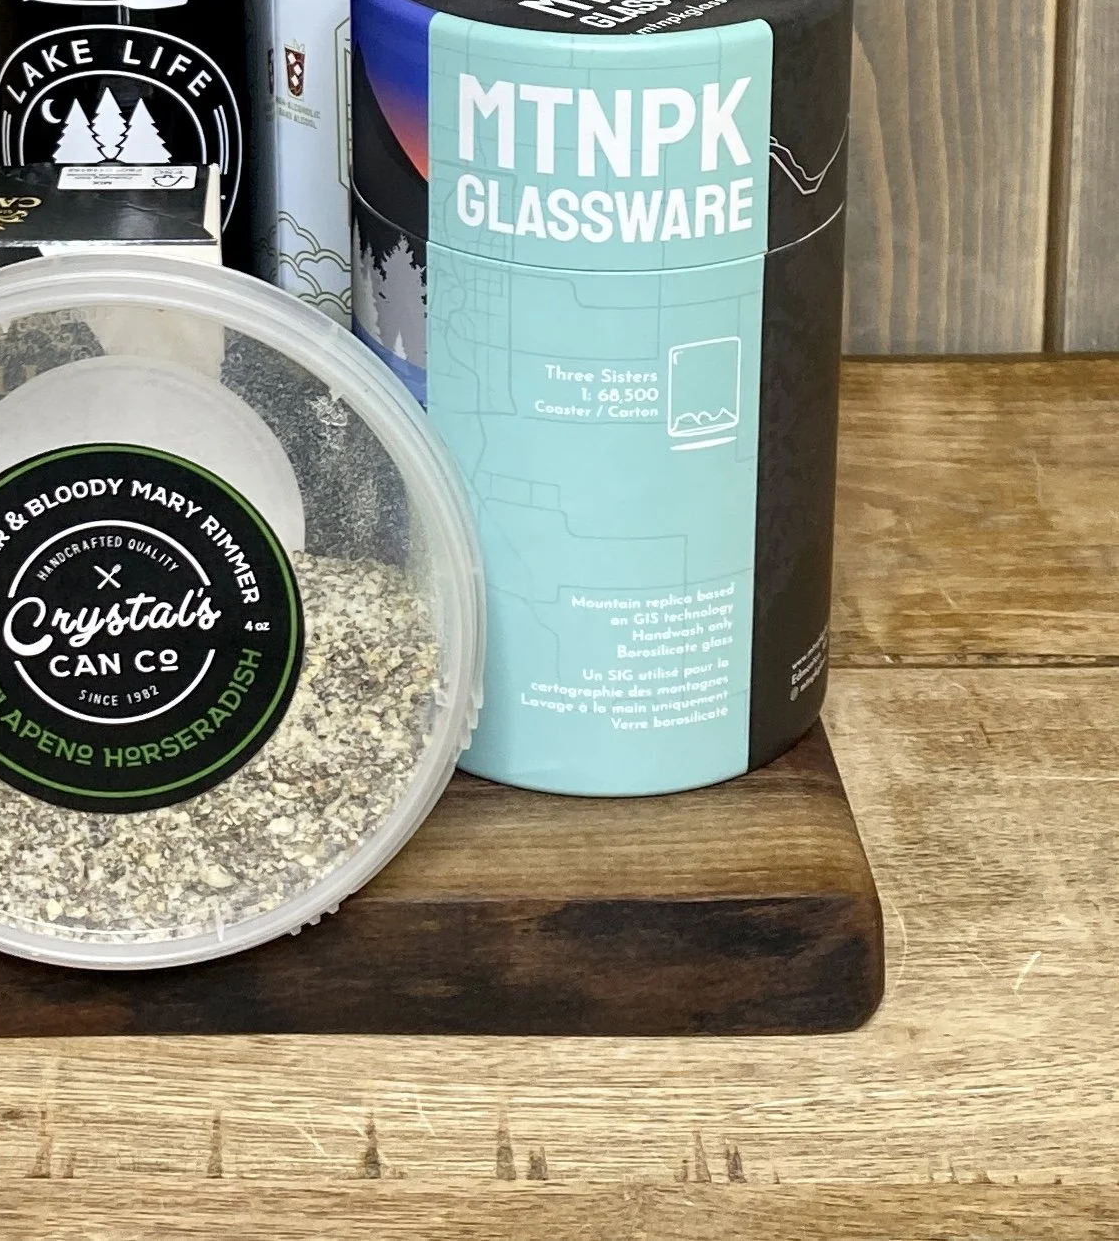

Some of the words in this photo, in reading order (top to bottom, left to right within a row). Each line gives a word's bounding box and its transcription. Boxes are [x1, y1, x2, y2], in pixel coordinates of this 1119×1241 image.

[6, 39, 94, 105] LAKE
[123, 39, 213, 97] LIFE
[458, 72, 753, 178] MTNPK
[456, 173, 754, 244] GLASSWARE
[545, 364, 595, 384] Three
[601, 369, 658, 384] Sisters
[581, 387, 592, 402] 1:
[597, 387, 659, 404] 68,500
[534, 399, 592, 418] Coaster
[607, 405, 659, 418] Carton
[4, 510, 29, 531] &
[23, 478, 124, 517] BLOODY
[131, 480, 203, 519] MARY
[200, 514, 260, 604] RIMMER
[35, 535, 123, 582] HANDCRAFTED
[127, 538, 179, 572] QUALITY
[571, 596, 641, 609] Mountain
[646, 593, 692, 609] replica
[696, 582, 735, 602] based
[3, 587, 222, 656] Crystal's
[244, 621, 253, 631] 4
[255, 622, 271, 631] oz
[611, 617, 628, 626] on
[633, 612, 659, 625] GIS
[664, 603, 734, 623] technology
[632, 624, 704, 641] Handwash
[708, 618, 733, 632] only
[617, 643, 697, 659] Borosilicate
[702, 635, 734, 652] glass
[49, 652, 122, 678] CAN
[582, 668, 603, 682] Un
[608, 669, 634, 682] SIG
[638, 666, 679, 681] utilisé
[683, 663, 713, 678] pour
[717, 657, 730, 668] la
[78, 689, 119, 707] SINCE
[127, 685, 161, 706] 1982
[531, 680, 625, 699] cartographie
[628, 684, 652, 698] des
[657, 675, 730, 696] montagnes
[521, 692, 574, 713] Lavage
[593, 701, 608, 714] la
[612, 701, 648, 715] main
[652, 690, 729, 712] uniquement
[610, 717, 649, 731] Verre
